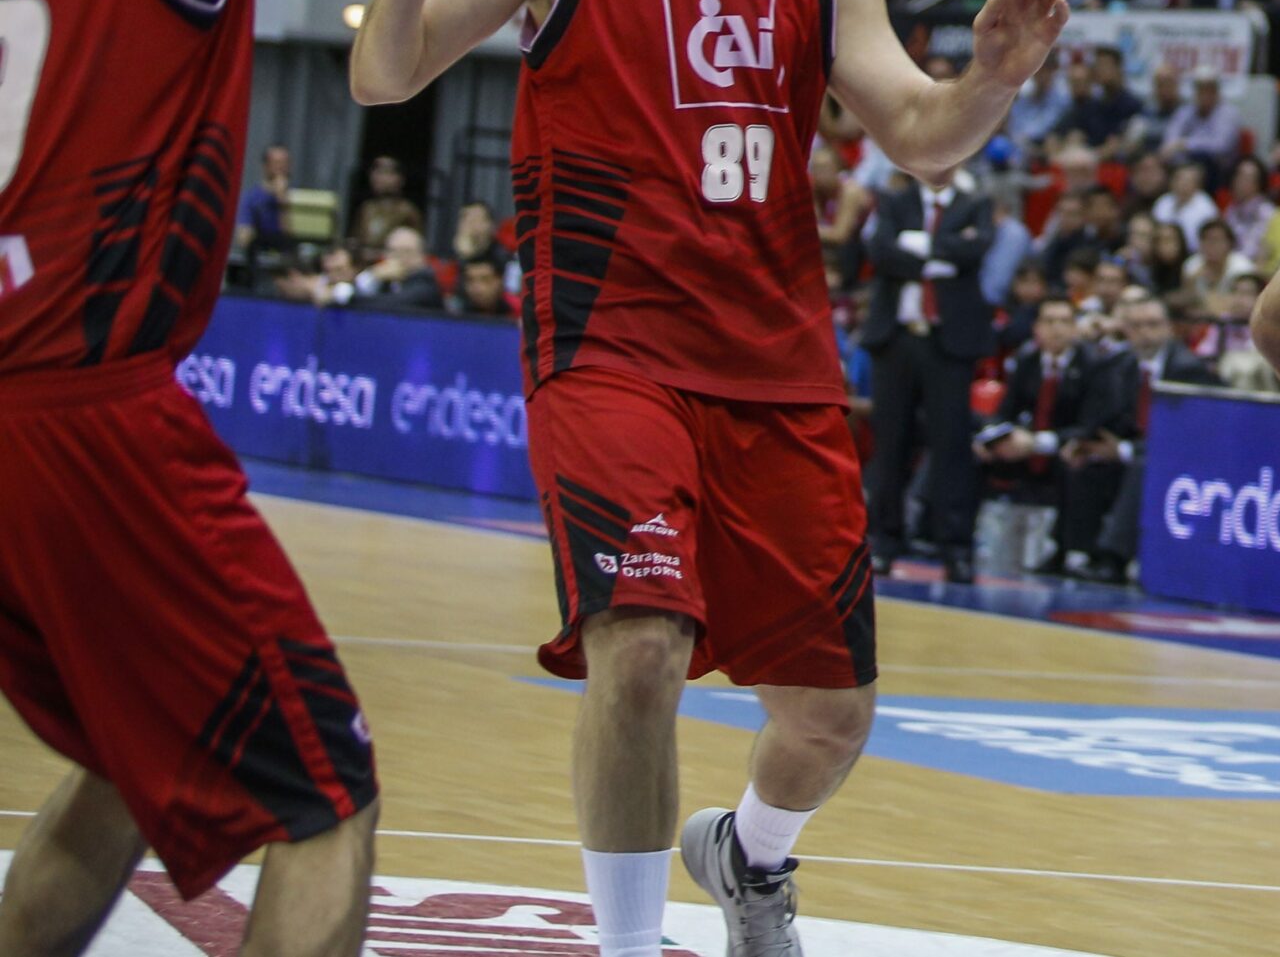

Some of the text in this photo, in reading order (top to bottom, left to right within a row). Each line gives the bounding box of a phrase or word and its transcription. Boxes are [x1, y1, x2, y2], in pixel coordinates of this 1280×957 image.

[701, 123, 776, 204] 89
[250, 353, 376, 430] endesa
[391, 370, 526, 449] endesa
